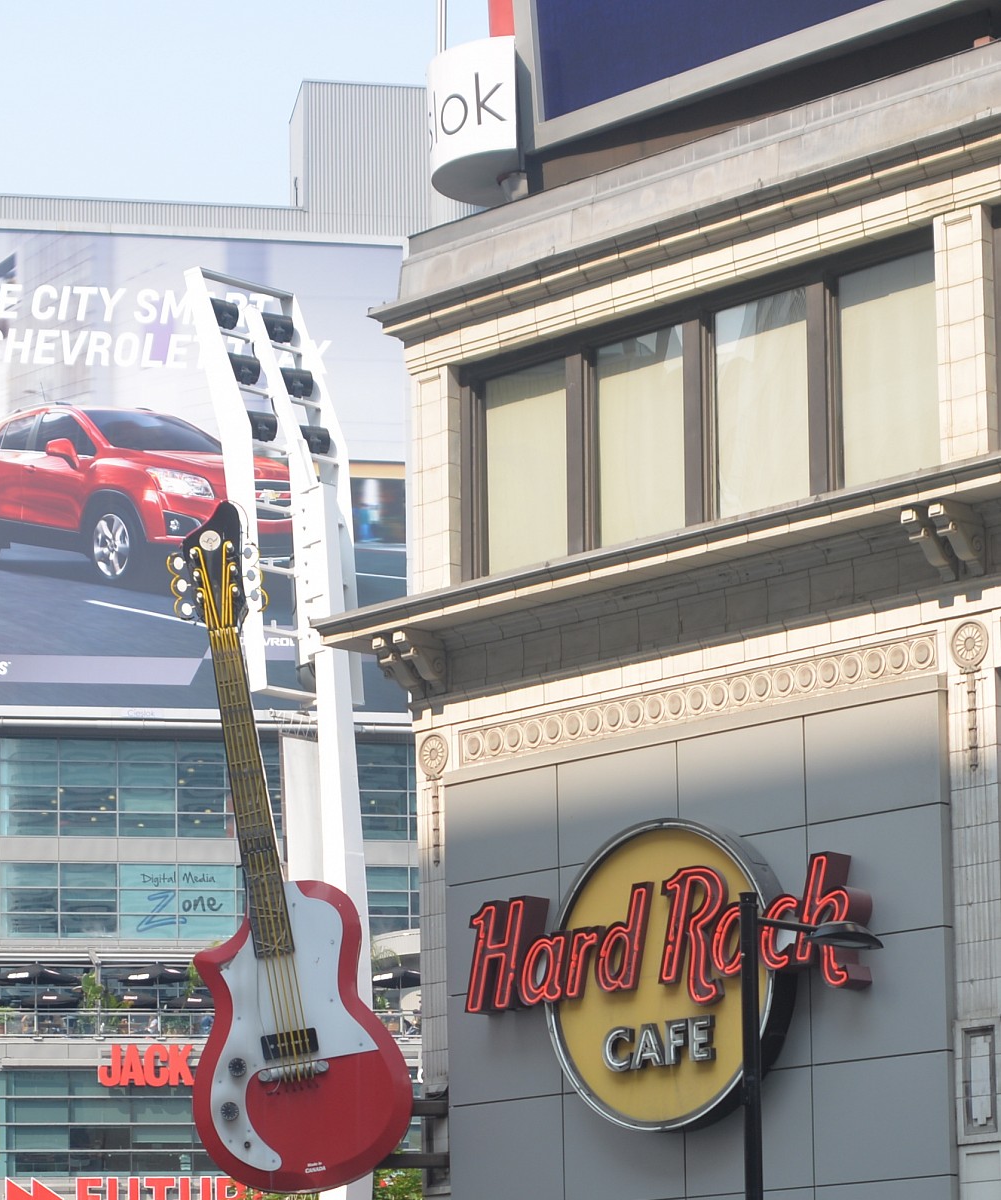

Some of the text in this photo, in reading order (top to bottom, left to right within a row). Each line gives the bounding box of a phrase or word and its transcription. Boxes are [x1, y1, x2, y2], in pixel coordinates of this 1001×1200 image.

[31, 284, 126, 323] CITY
[134, 288, 274, 330] SMRT
[140, 871, 216, 887] Digital Media
[136, 889, 224, 933] Zone
[658, 850, 873, 1006] Rock
[465, 881, 656, 1014] Hard
[98, 1044, 195, 1087] JACK
[604, 1014, 716, 1072] CAFE
